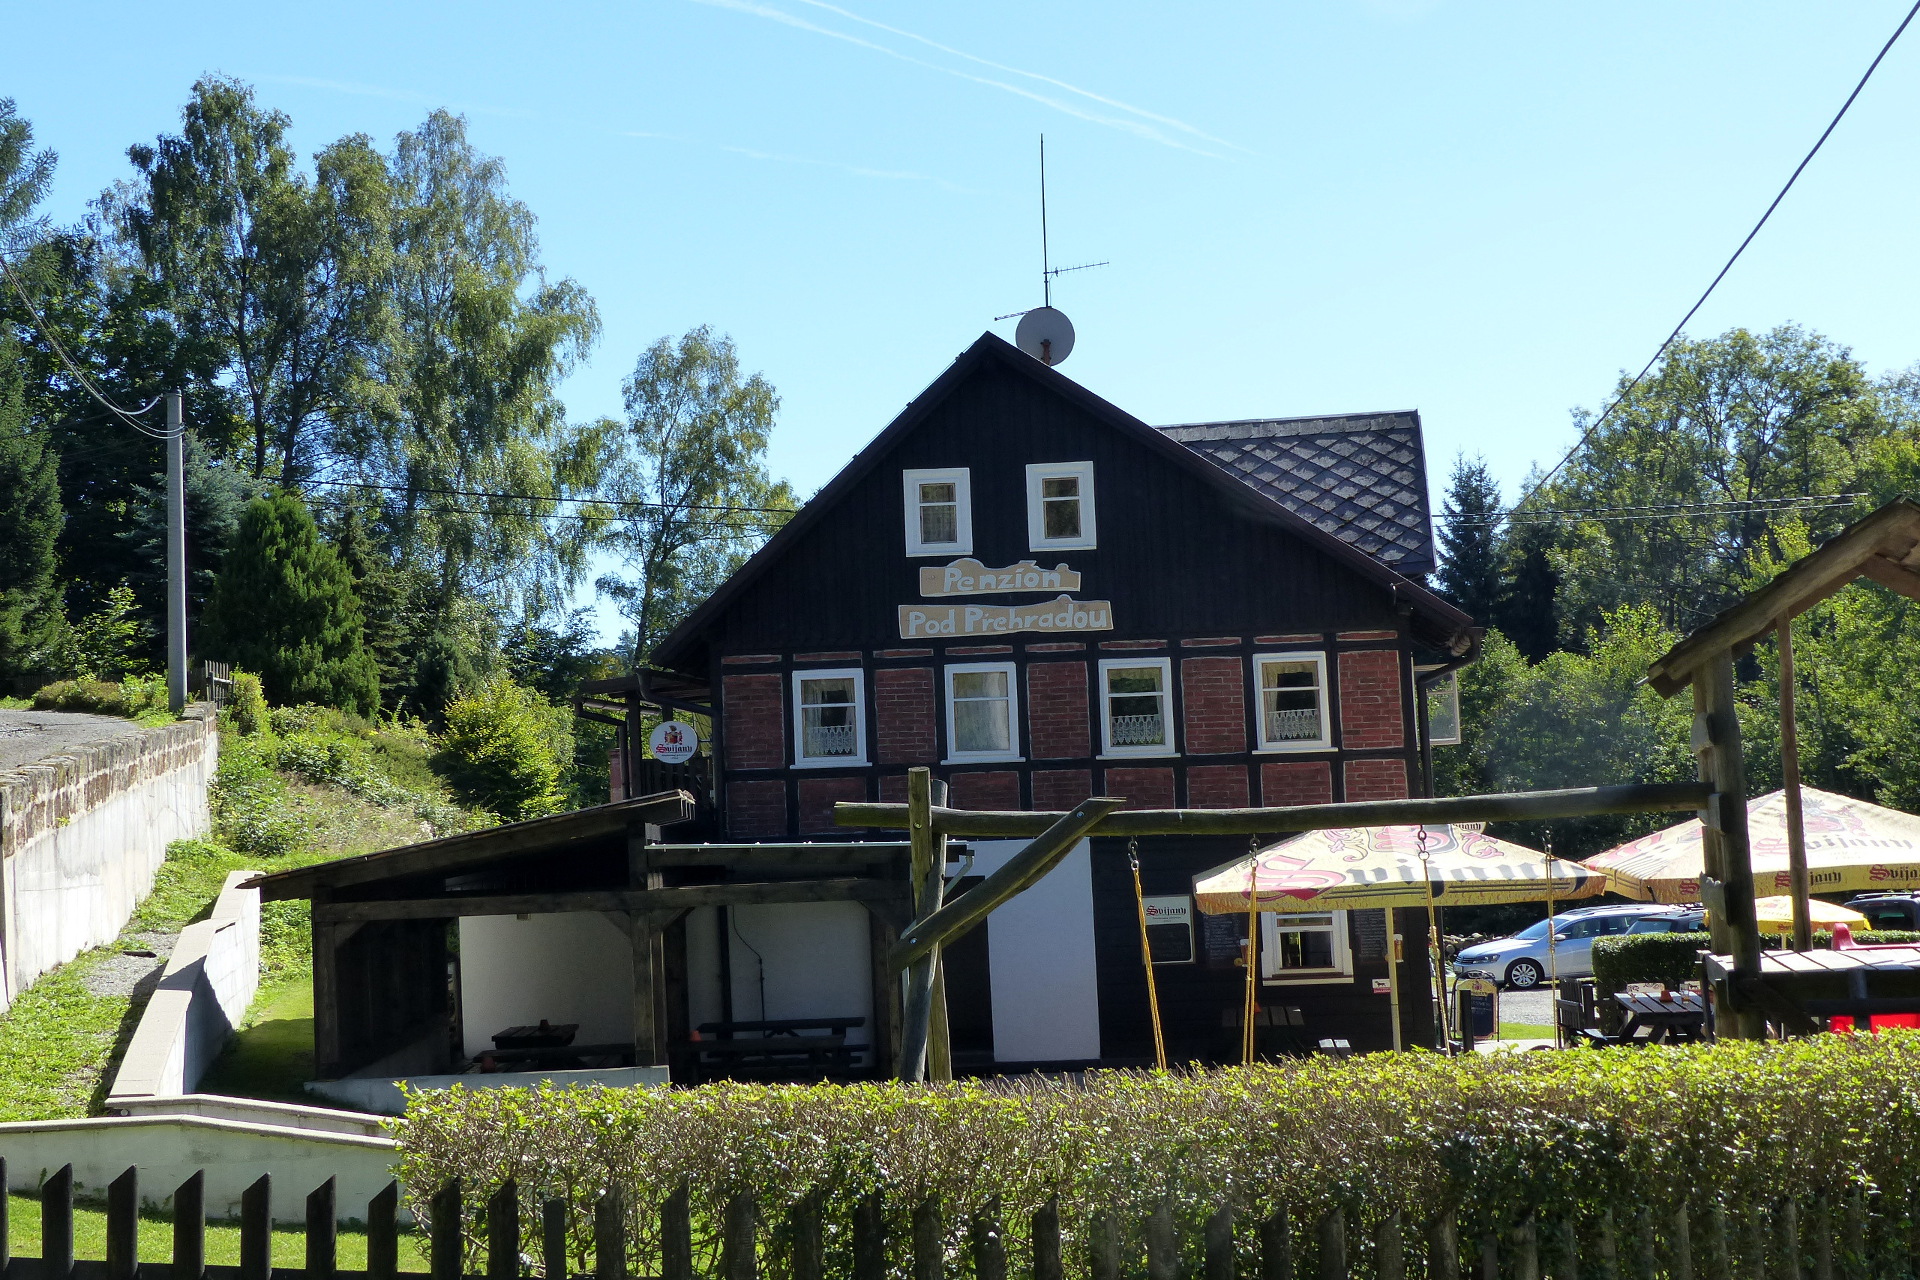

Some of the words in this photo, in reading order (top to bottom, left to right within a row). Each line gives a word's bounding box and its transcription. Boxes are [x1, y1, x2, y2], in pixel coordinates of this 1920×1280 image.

[908, 608, 956, 636] Pod
[655, 743, 693, 753] Svijany
[1774, 870, 1842, 888] Sjany
[1145, 904, 1187, 917] Svijany
